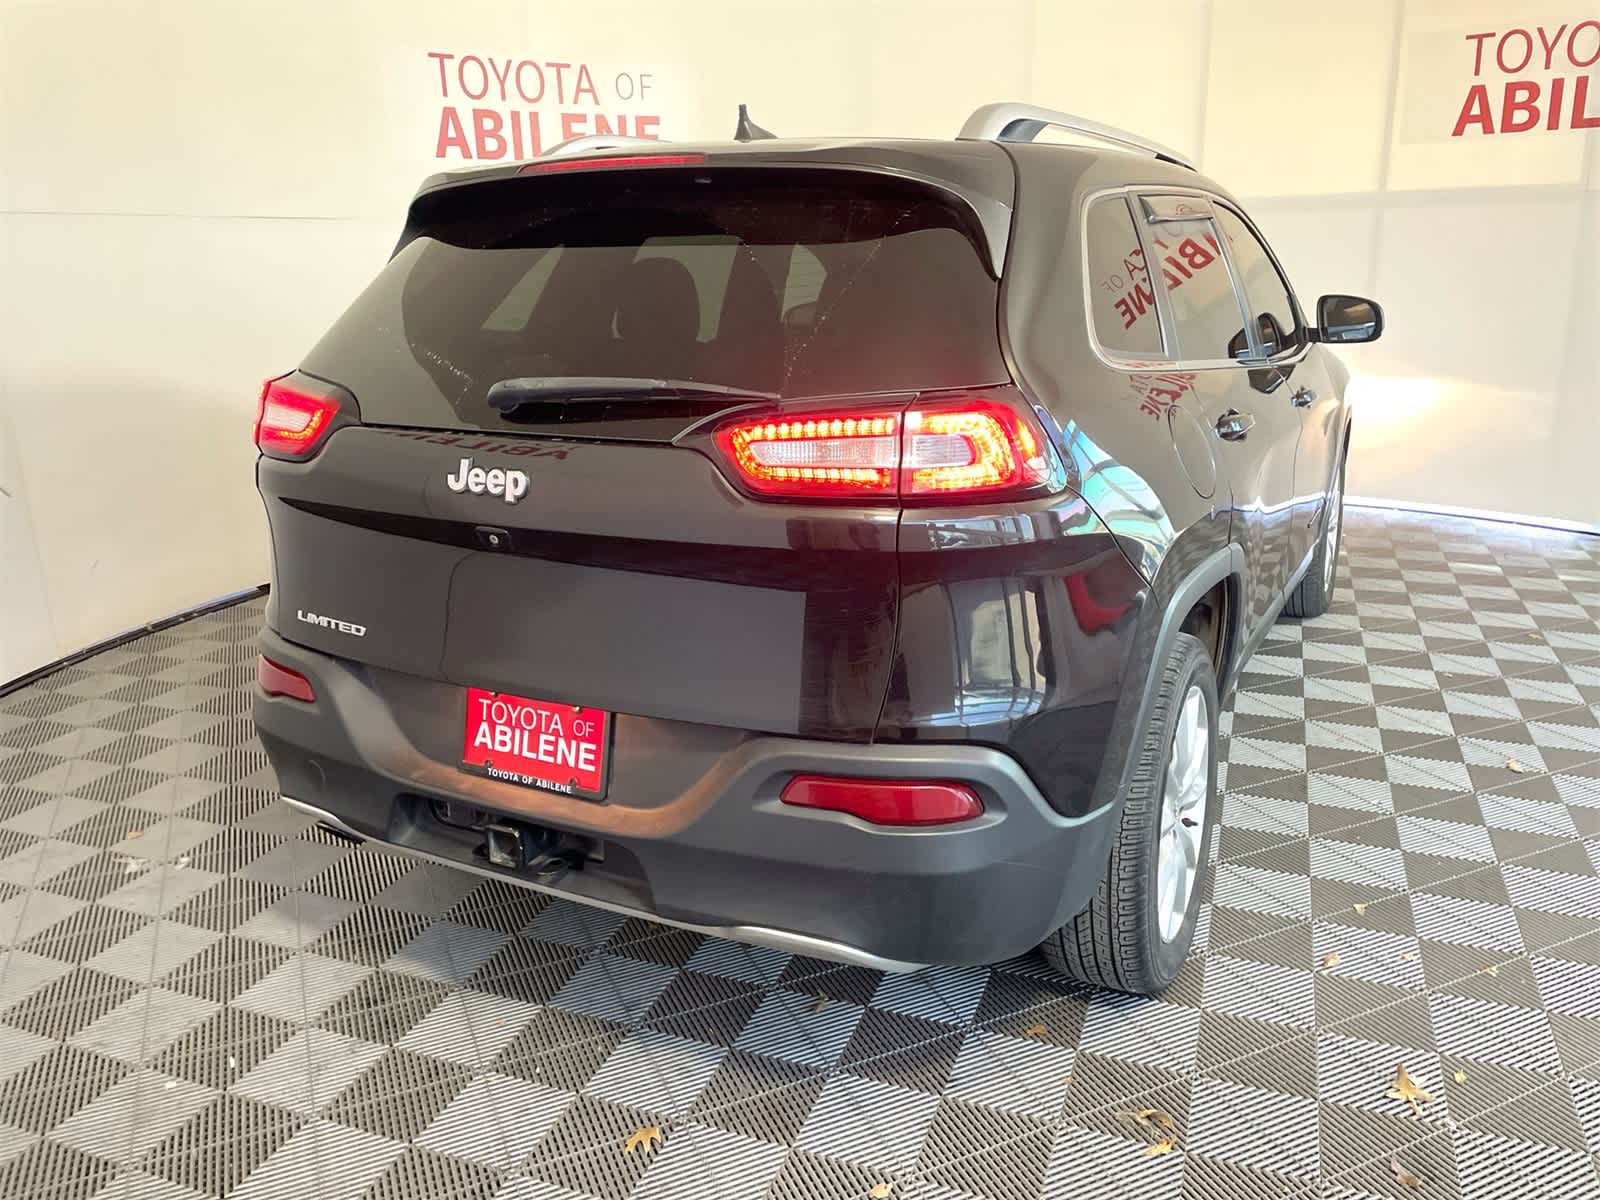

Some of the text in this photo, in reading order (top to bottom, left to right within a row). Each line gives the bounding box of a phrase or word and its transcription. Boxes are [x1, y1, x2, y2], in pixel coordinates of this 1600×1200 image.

[1465, 20, 1600, 76] TOYO
[427, 52, 653, 106] TOYOTA OF
[1451, 75, 1600, 137] ABIL
[447, 456, 530, 505] Jeep
[297, 609, 367, 637] LIMITED
[478, 698, 596, 737] TOYOTA OF
[473, 721, 597, 772] ABILENE
[487, 767, 573, 794] TOYOTA OF ABILENE
